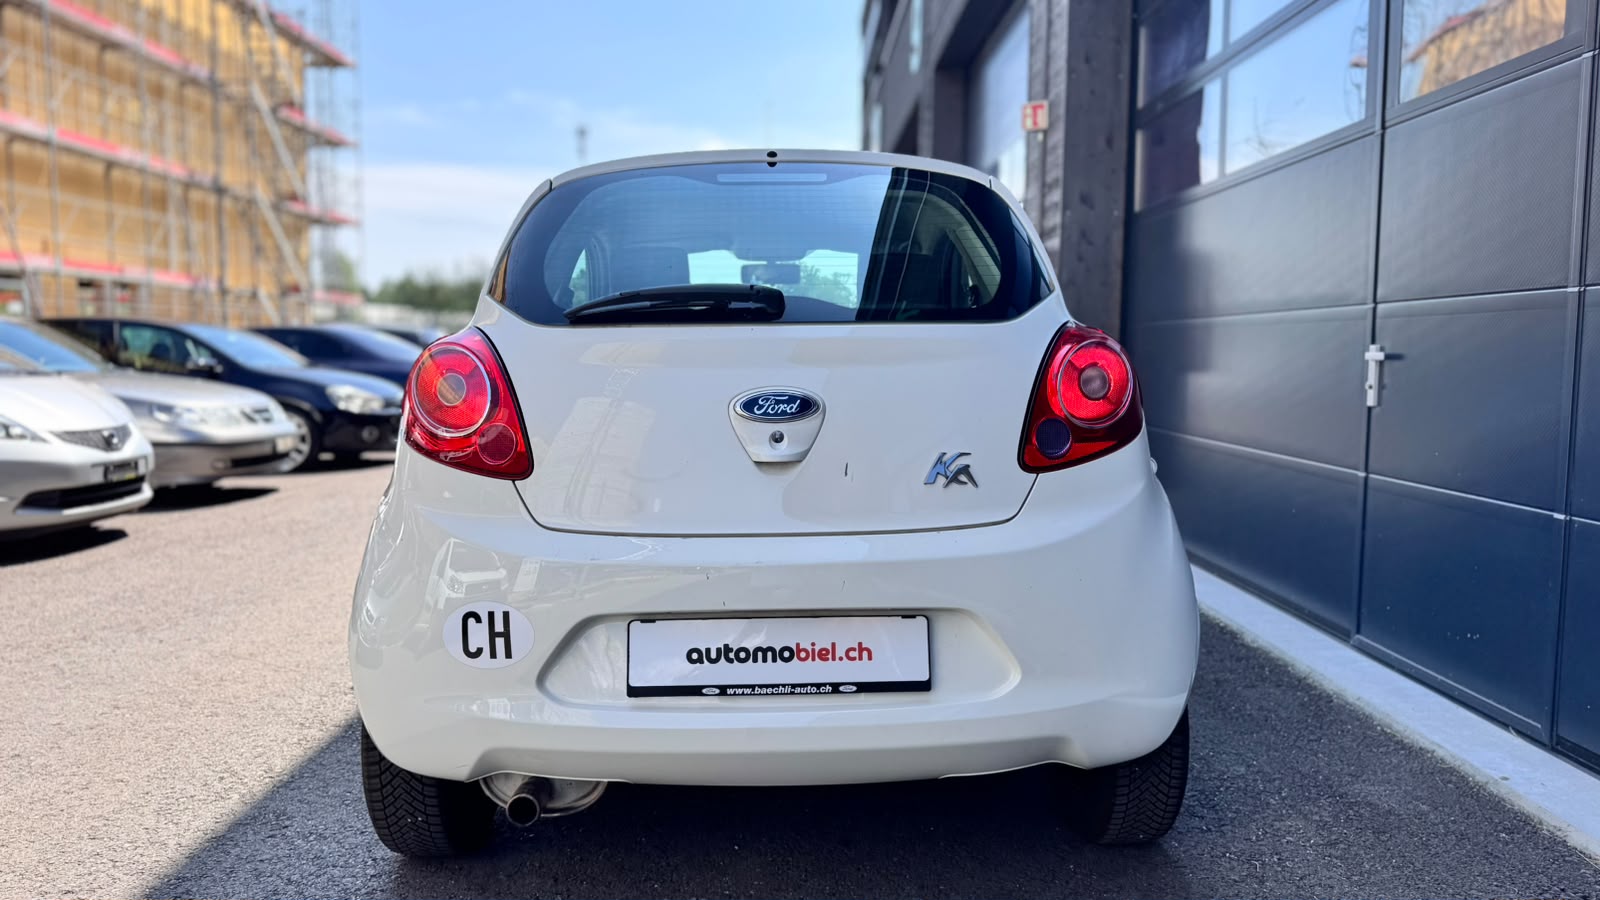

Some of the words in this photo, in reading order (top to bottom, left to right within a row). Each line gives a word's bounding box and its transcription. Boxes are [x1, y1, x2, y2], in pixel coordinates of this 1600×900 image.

[754, 396, 800, 415] Ford
[462, 611, 512, 659] CH
[686, 642, 873, 664] automobiel.ch
[726, 685, 832, 695] www.baechli-auto.ch
